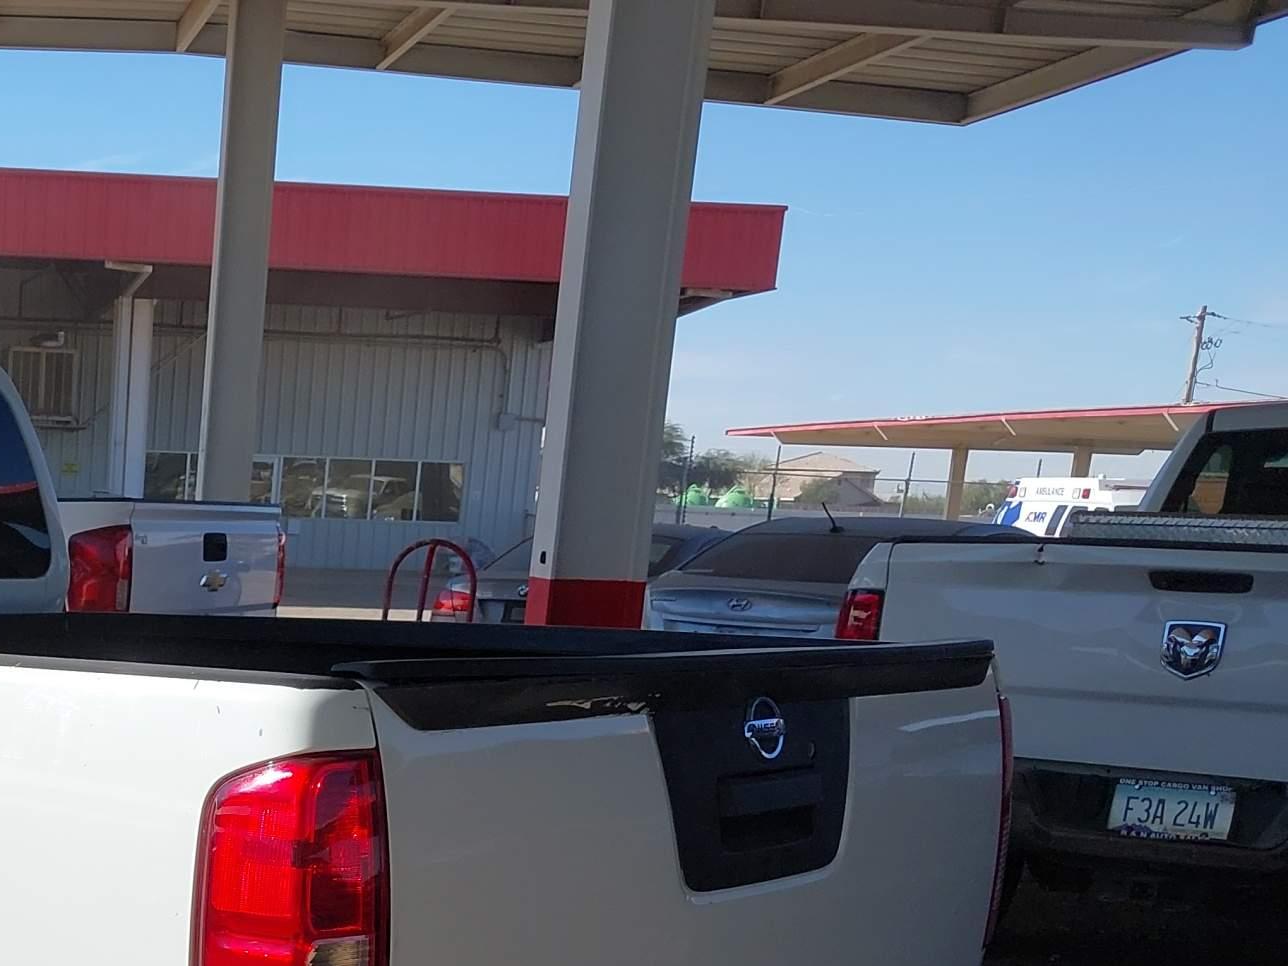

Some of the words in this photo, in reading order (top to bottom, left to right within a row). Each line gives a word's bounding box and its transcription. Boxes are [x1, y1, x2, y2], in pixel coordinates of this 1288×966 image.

[1119, 777, 1137, 786] ONE
[1138, 780, 1159, 788] STOP
[1160, 781, 1190, 790] CARGO
[1191, 784, 1209, 792] VAN
[1122, 795, 1166, 825] F3A
[1172, 799, 1220, 830] 24W
